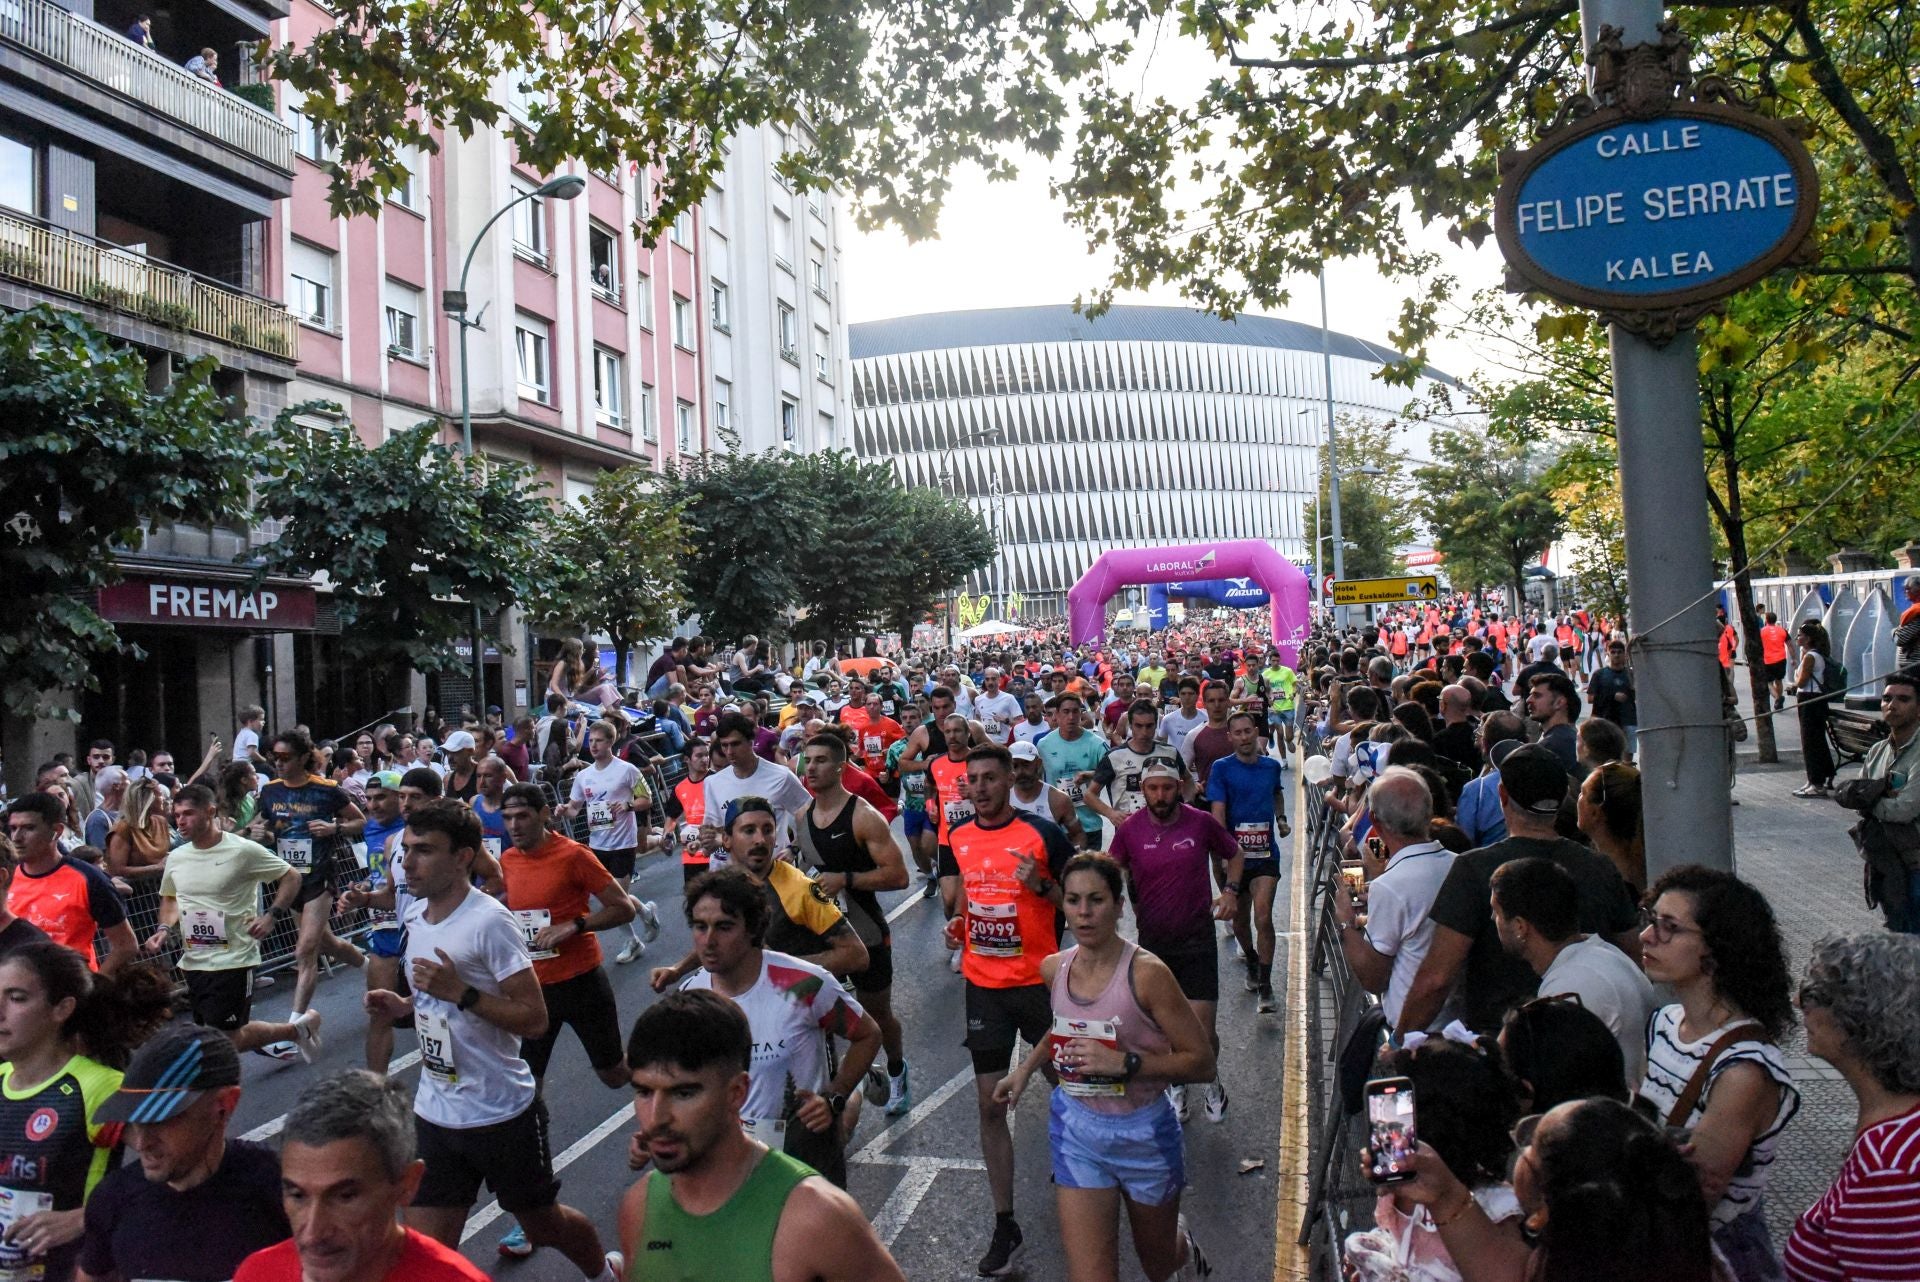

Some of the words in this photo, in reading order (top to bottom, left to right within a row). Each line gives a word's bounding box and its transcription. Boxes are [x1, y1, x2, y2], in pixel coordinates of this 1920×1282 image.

[1596, 125, 1702, 158] CALLE
[1517, 191, 1625, 235] FELIPE
[1643, 173, 1795, 222] SERRATE
[1605, 250, 1715, 283] KALEA
[1146, 560, 1194, 573] LABORAL
[150, 584, 278, 620] FREMAP
[591, 810, 605, 820] 279
[1237, 834, 1268, 844] 20989
[282, 850, 306, 860] 1187
[192, 924, 215, 936] 880
[970, 919, 1015, 936] 20999
